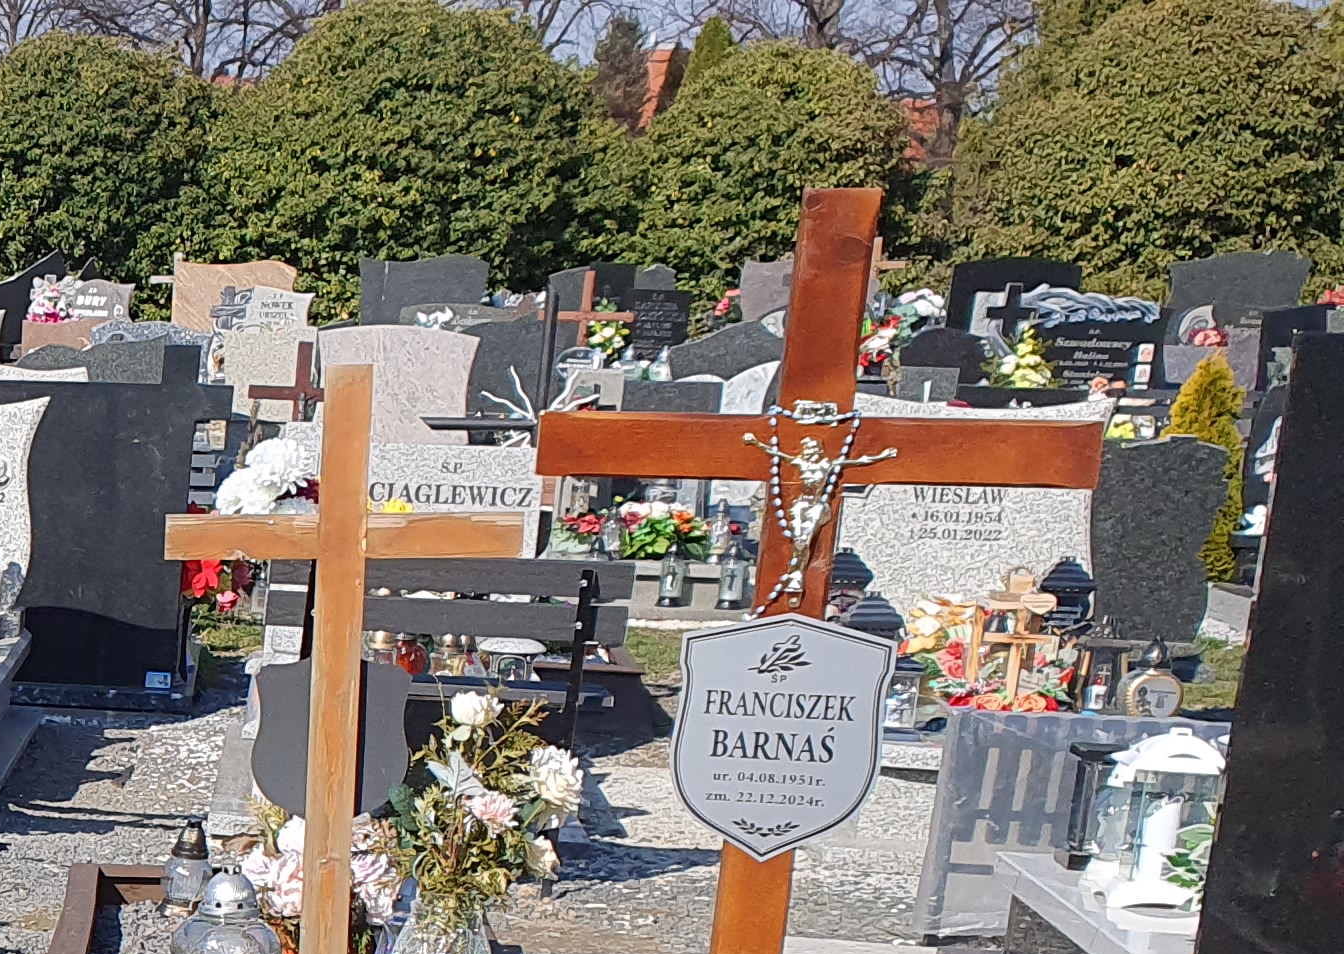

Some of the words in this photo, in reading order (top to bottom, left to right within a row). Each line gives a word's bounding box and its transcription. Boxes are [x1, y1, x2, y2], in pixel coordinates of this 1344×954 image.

[704, 690, 856, 721] FRANCISZEK
[710, 727, 836, 763] BARNAŚ
[713, 773, 731, 782] ur.
[738, 771, 825, 786] 04.08.1951r.
[706, 792, 730, 801] zm.
[736, 792, 824, 807] 22.12.2024r.
